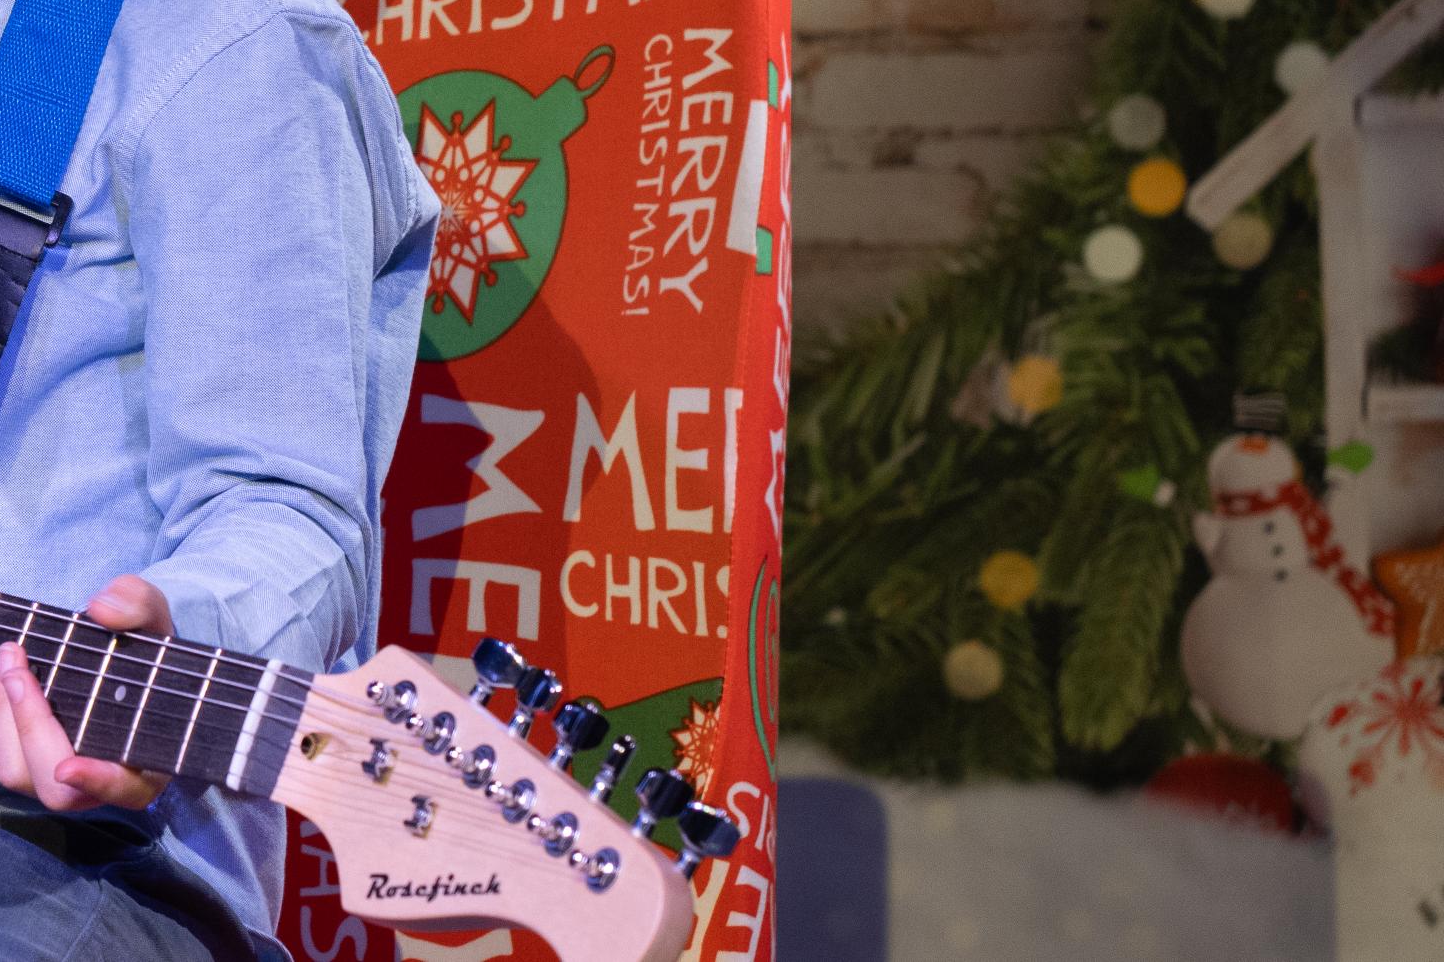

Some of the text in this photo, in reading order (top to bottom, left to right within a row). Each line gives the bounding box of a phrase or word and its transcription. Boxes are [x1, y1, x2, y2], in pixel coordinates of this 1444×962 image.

[621, 33, 673, 316] CHRISTMAS!
[659, 28, 734, 315] MERRY
[366, 872, 500, 903] Rosefinch
